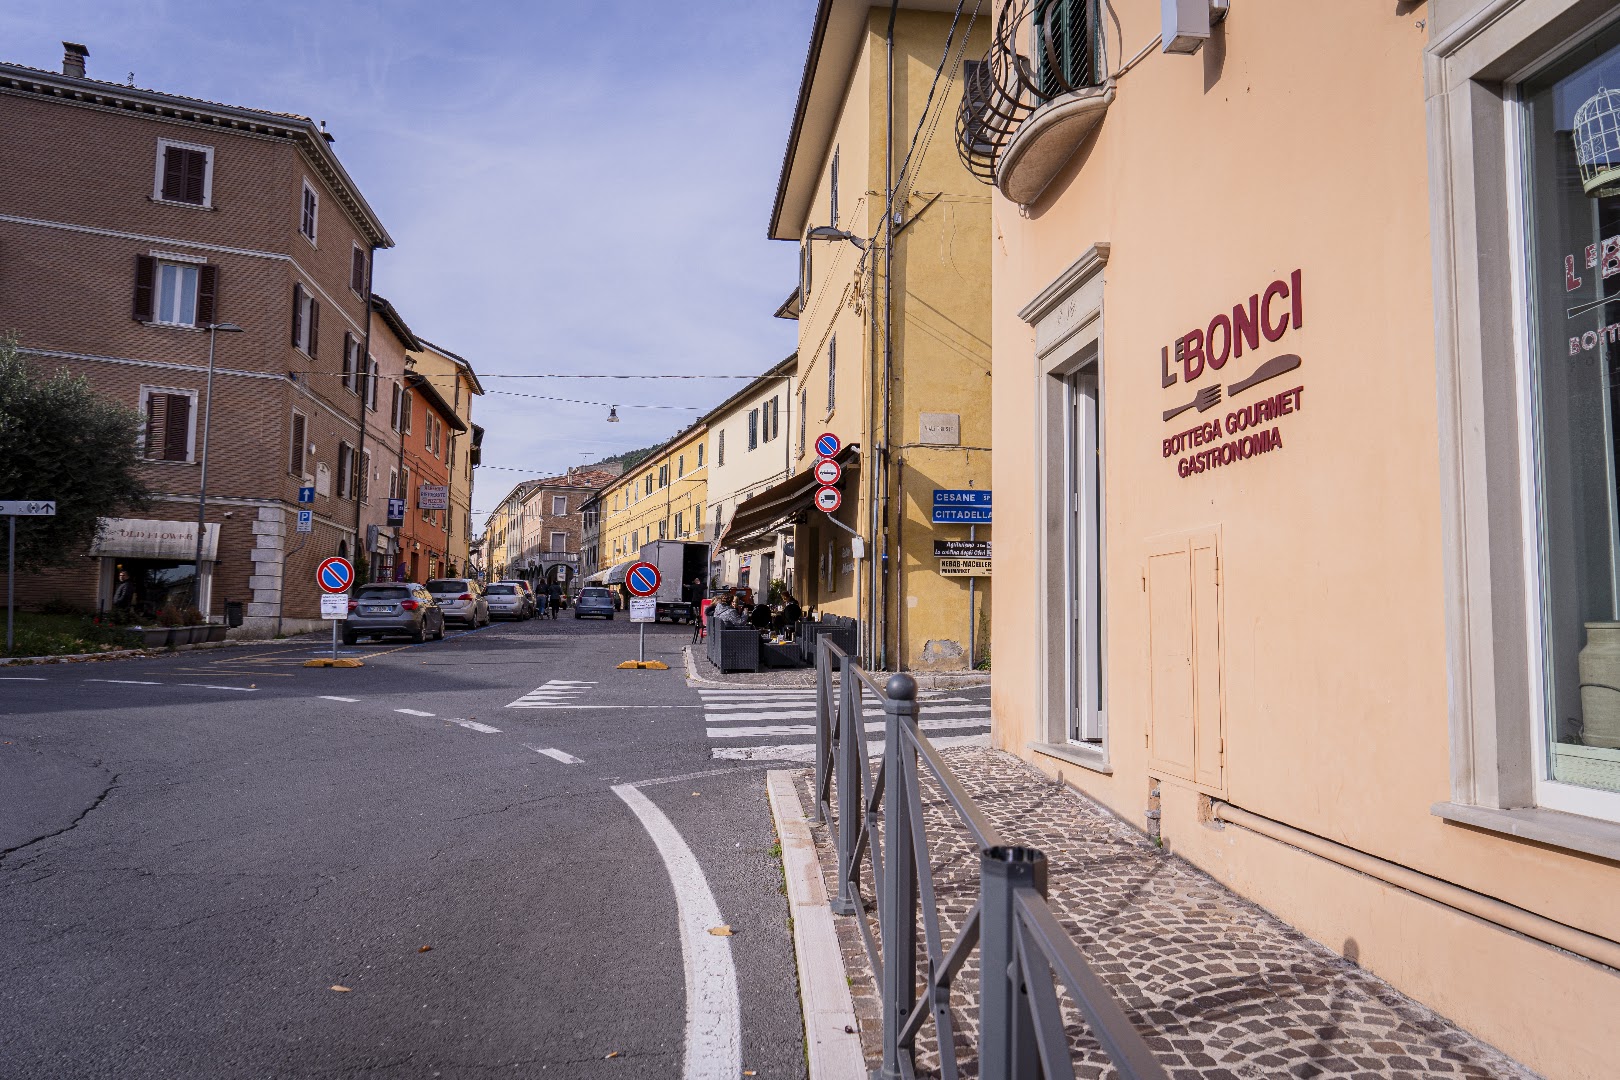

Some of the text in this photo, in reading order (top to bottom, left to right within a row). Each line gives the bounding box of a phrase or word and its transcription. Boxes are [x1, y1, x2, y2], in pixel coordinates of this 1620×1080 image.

[1183, 268, 1302, 382] BONCI
[1162, 385, 1304, 458] BOTTEGA GOURMET
[1177, 426, 1283, 479] GASTRONOMIA
[936, 493, 976, 502] CESANE
[147, 532, 193, 541] FLOWER
